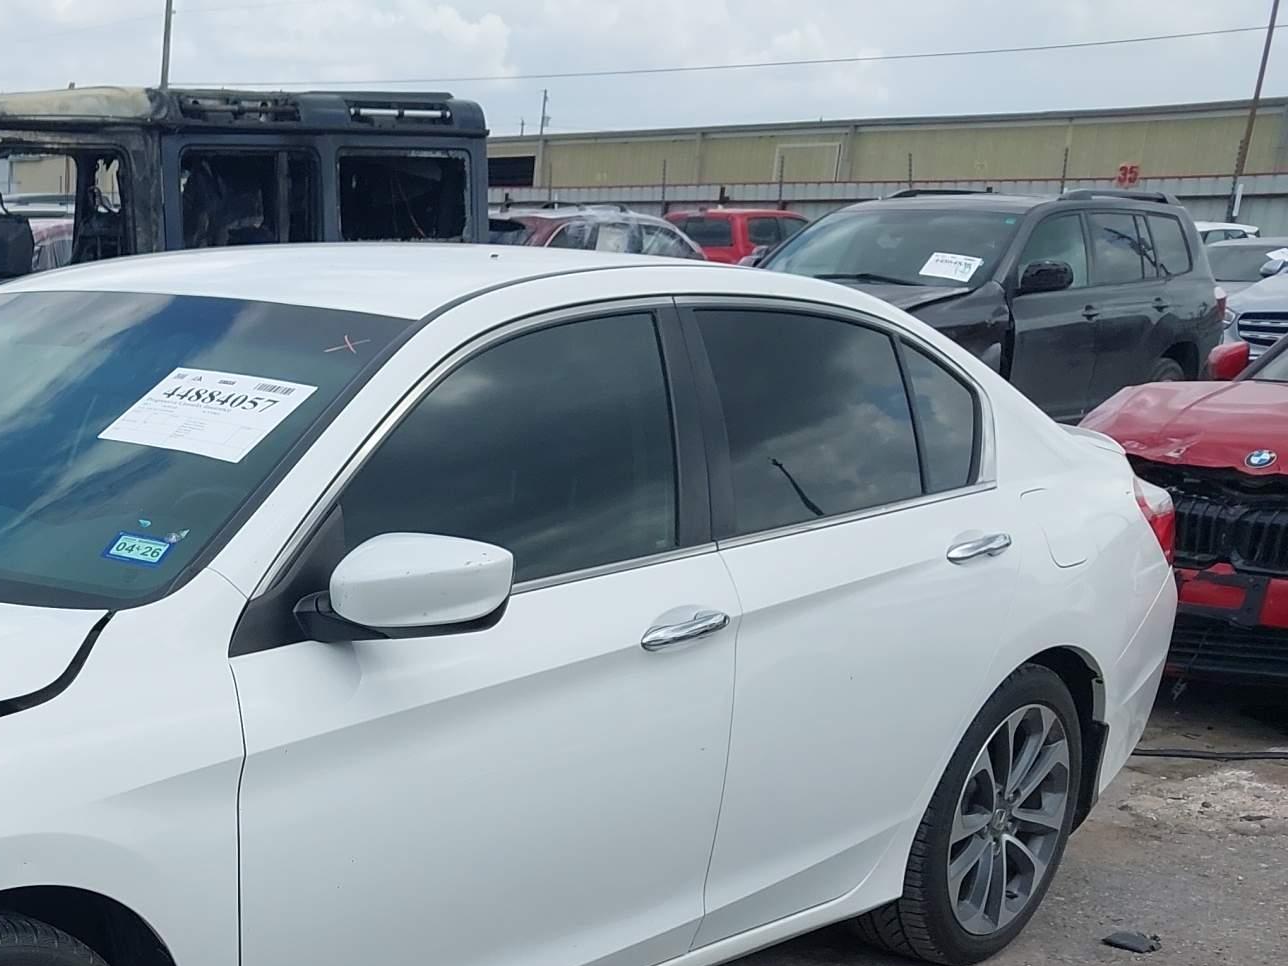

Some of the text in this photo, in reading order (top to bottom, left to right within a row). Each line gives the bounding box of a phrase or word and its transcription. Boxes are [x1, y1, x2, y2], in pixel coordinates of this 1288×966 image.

[1118, 165, 1139, 183] 35
[163, 385, 281, 413] 44884057
[115, 541, 135, 553] 04
[139, 545, 162, 558] 26
